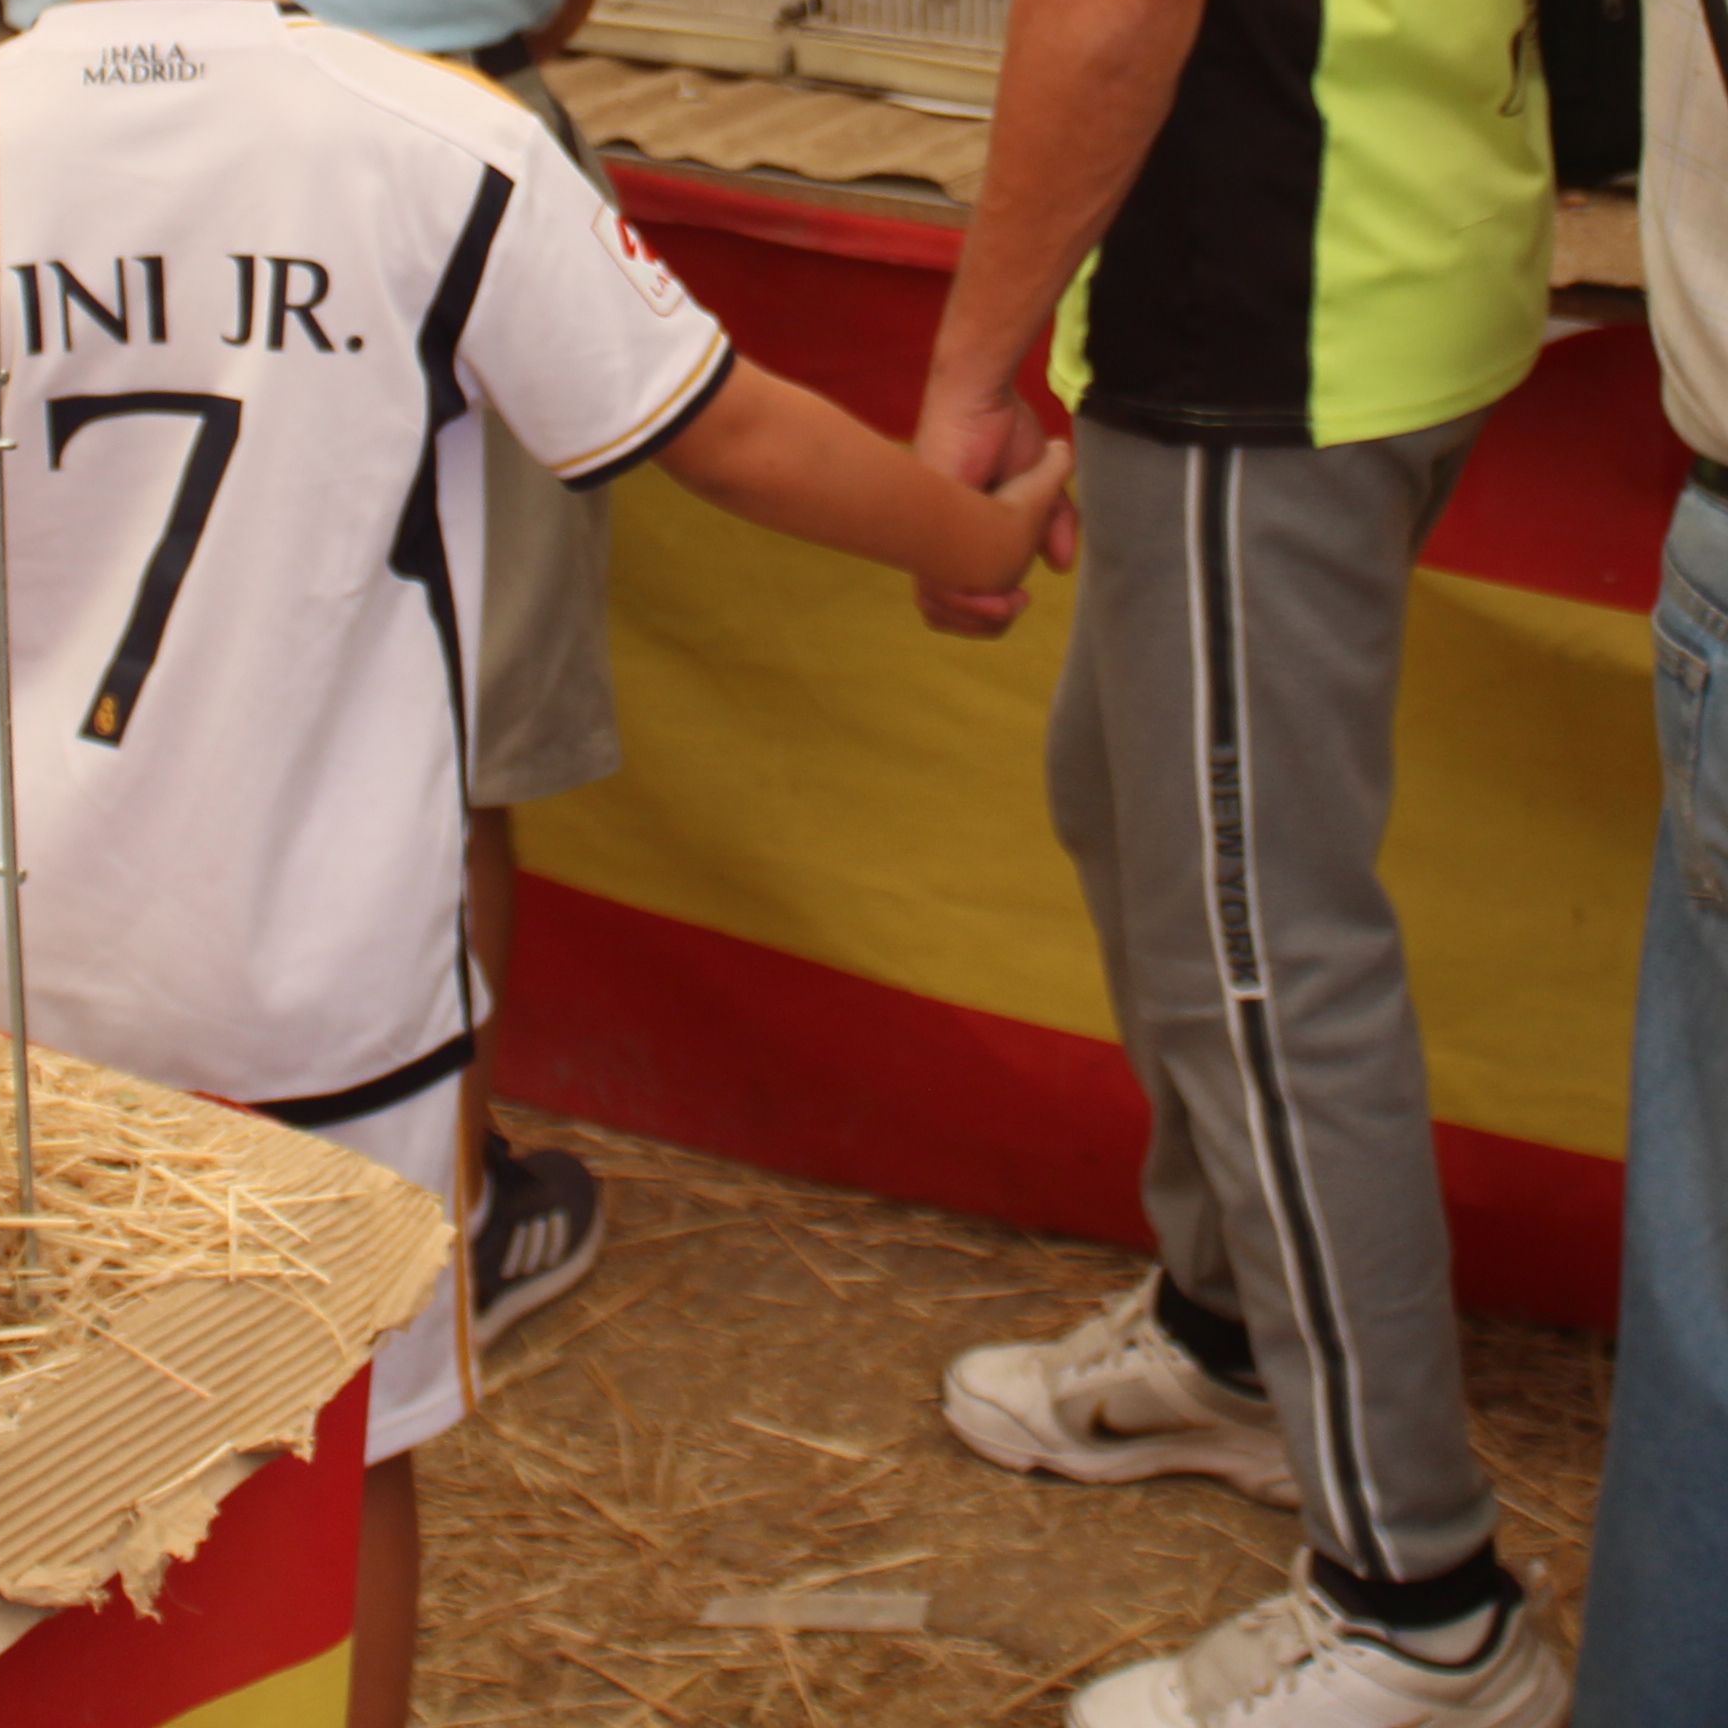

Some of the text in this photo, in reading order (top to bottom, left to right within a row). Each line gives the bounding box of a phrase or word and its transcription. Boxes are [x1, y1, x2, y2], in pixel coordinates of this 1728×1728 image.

[81, 62, 206, 86] MADRID!
[220, 253, 363, 355] JR.
[46, 390, 244, 749] 7
